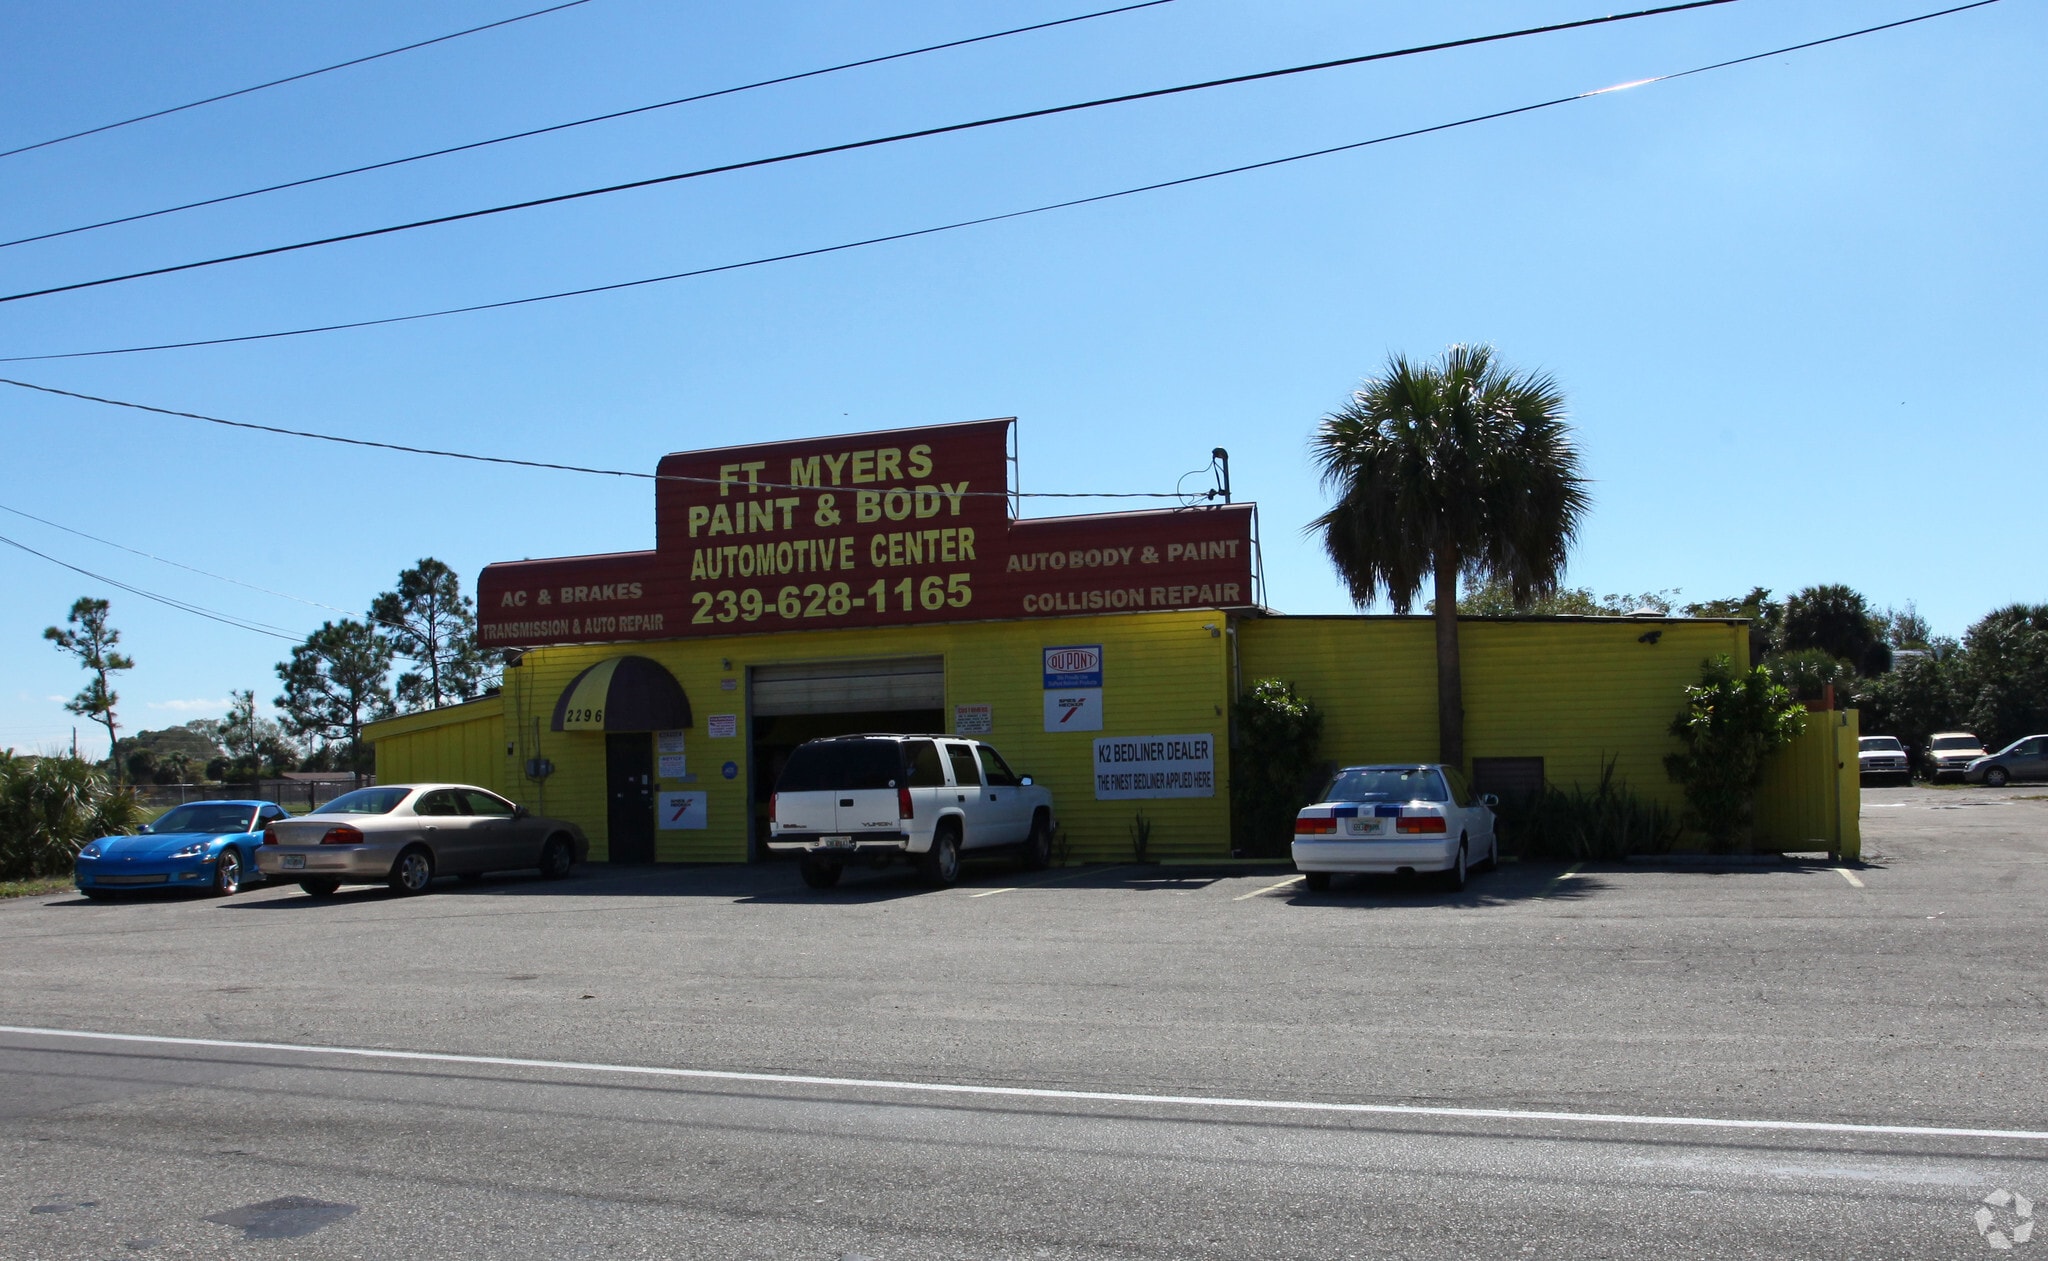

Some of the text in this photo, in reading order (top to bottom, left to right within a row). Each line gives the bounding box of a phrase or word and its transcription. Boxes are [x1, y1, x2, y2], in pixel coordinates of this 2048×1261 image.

[719, 444, 933, 496] FT. MYERS
[688, 481, 970, 538] PAINT & BODY
[690, 527, 977, 581] AUTOMOTIVE CENTER
[1140, 545, 1160, 564] &
[1167, 539, 1240, 562] PAINT
[501, 582, 643, 607] AC & BRAKES
[691, 572, 973, 624] 239-628-1165
[1023, 582, 1240, 613] COLLISION REPAIR
[482, 613, 664, 640] TRANSMISSION & AUTO REPAIR
[566, 708, 603, 723] 2296
[1099, 740, 1208, 763] K2 BEDLINER DEALER
[1097, 771, 1211, 791] THE FINEST BEDLINER APPLIED HERE
